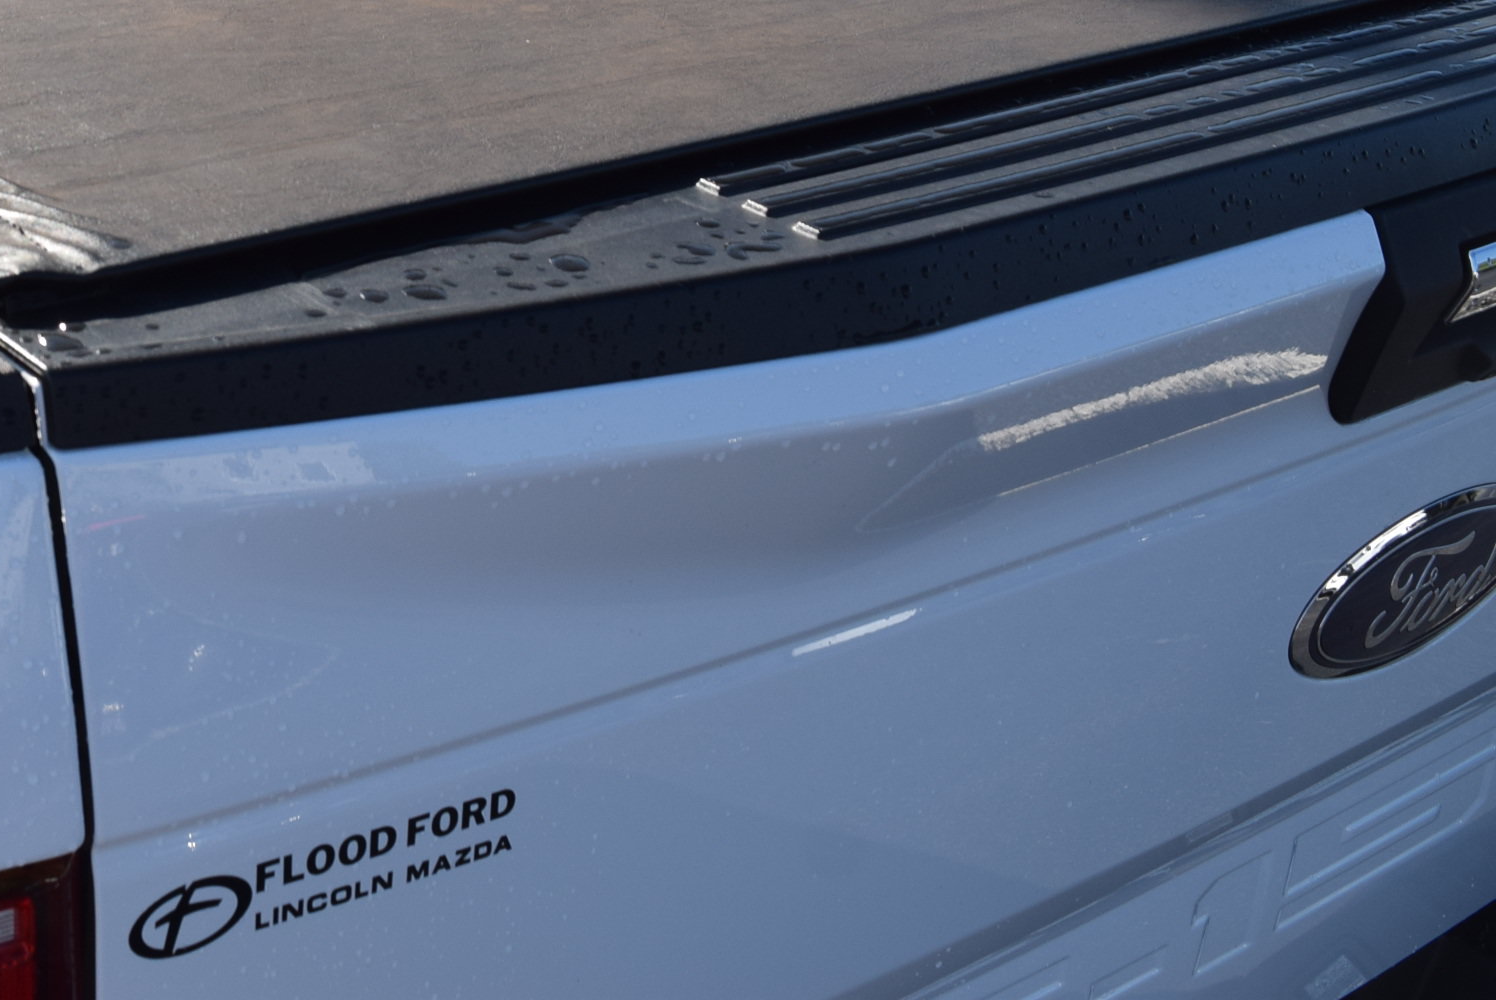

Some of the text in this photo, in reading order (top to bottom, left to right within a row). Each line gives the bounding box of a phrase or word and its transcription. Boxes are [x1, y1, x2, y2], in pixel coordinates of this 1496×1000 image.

[1365, 530, 1496, 648] Ford
[255, 834, 512, 931] LINCOLN MAZDA
[256, 788, 516, 894] FLOOD FORD
